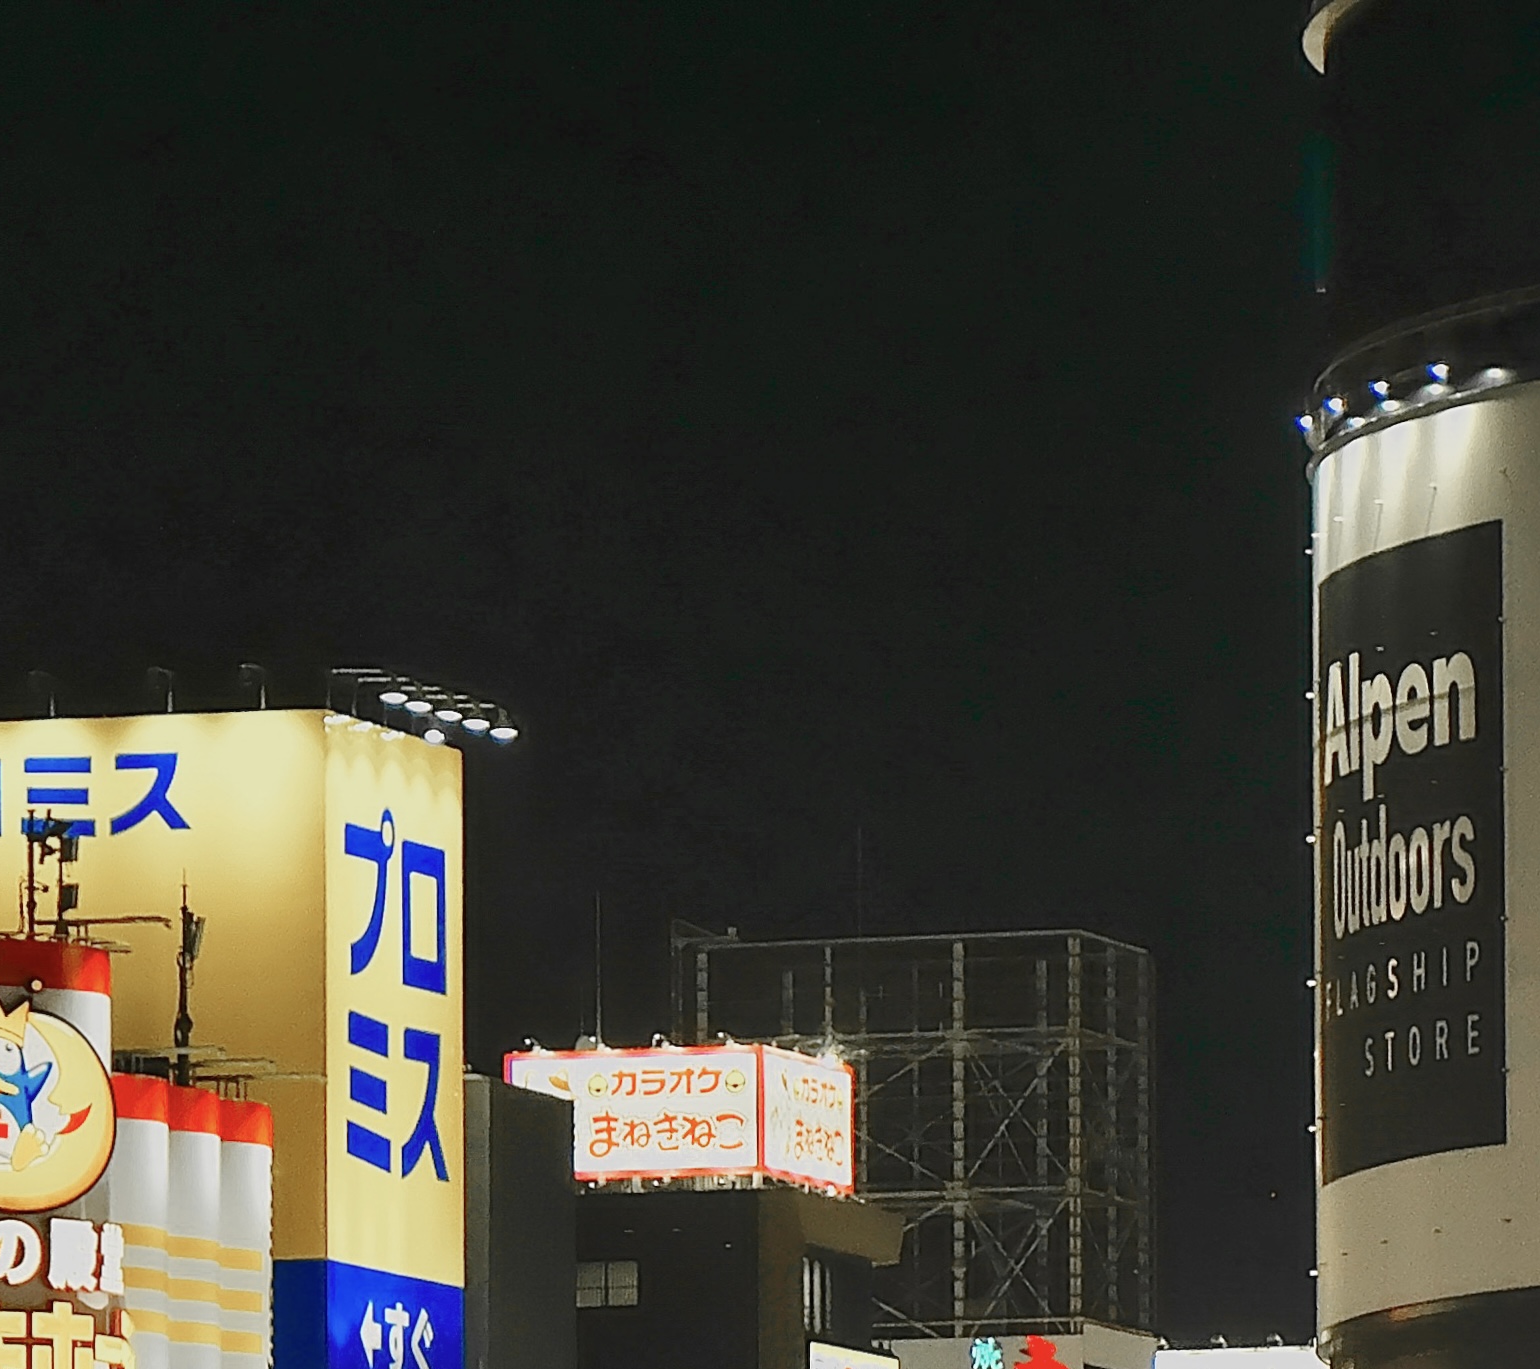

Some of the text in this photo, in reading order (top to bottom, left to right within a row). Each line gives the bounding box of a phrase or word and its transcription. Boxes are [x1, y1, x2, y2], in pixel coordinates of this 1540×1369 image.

[1321, 649, 1477, 802] Alpen
[1332, 806, 1477, 941] Outdoors
[1326, 940, 1482, 1024] FLAGSHIP
[1362, 1013, 1482, 1080] STORE
[610, 1067, 723, 1100] カラオケ
[799, 1075, 841, 1108] カラオケ
[588, 1110, 746, 1160] まねきねこ
[793, 1116, 846, 1169] まねきねこ
